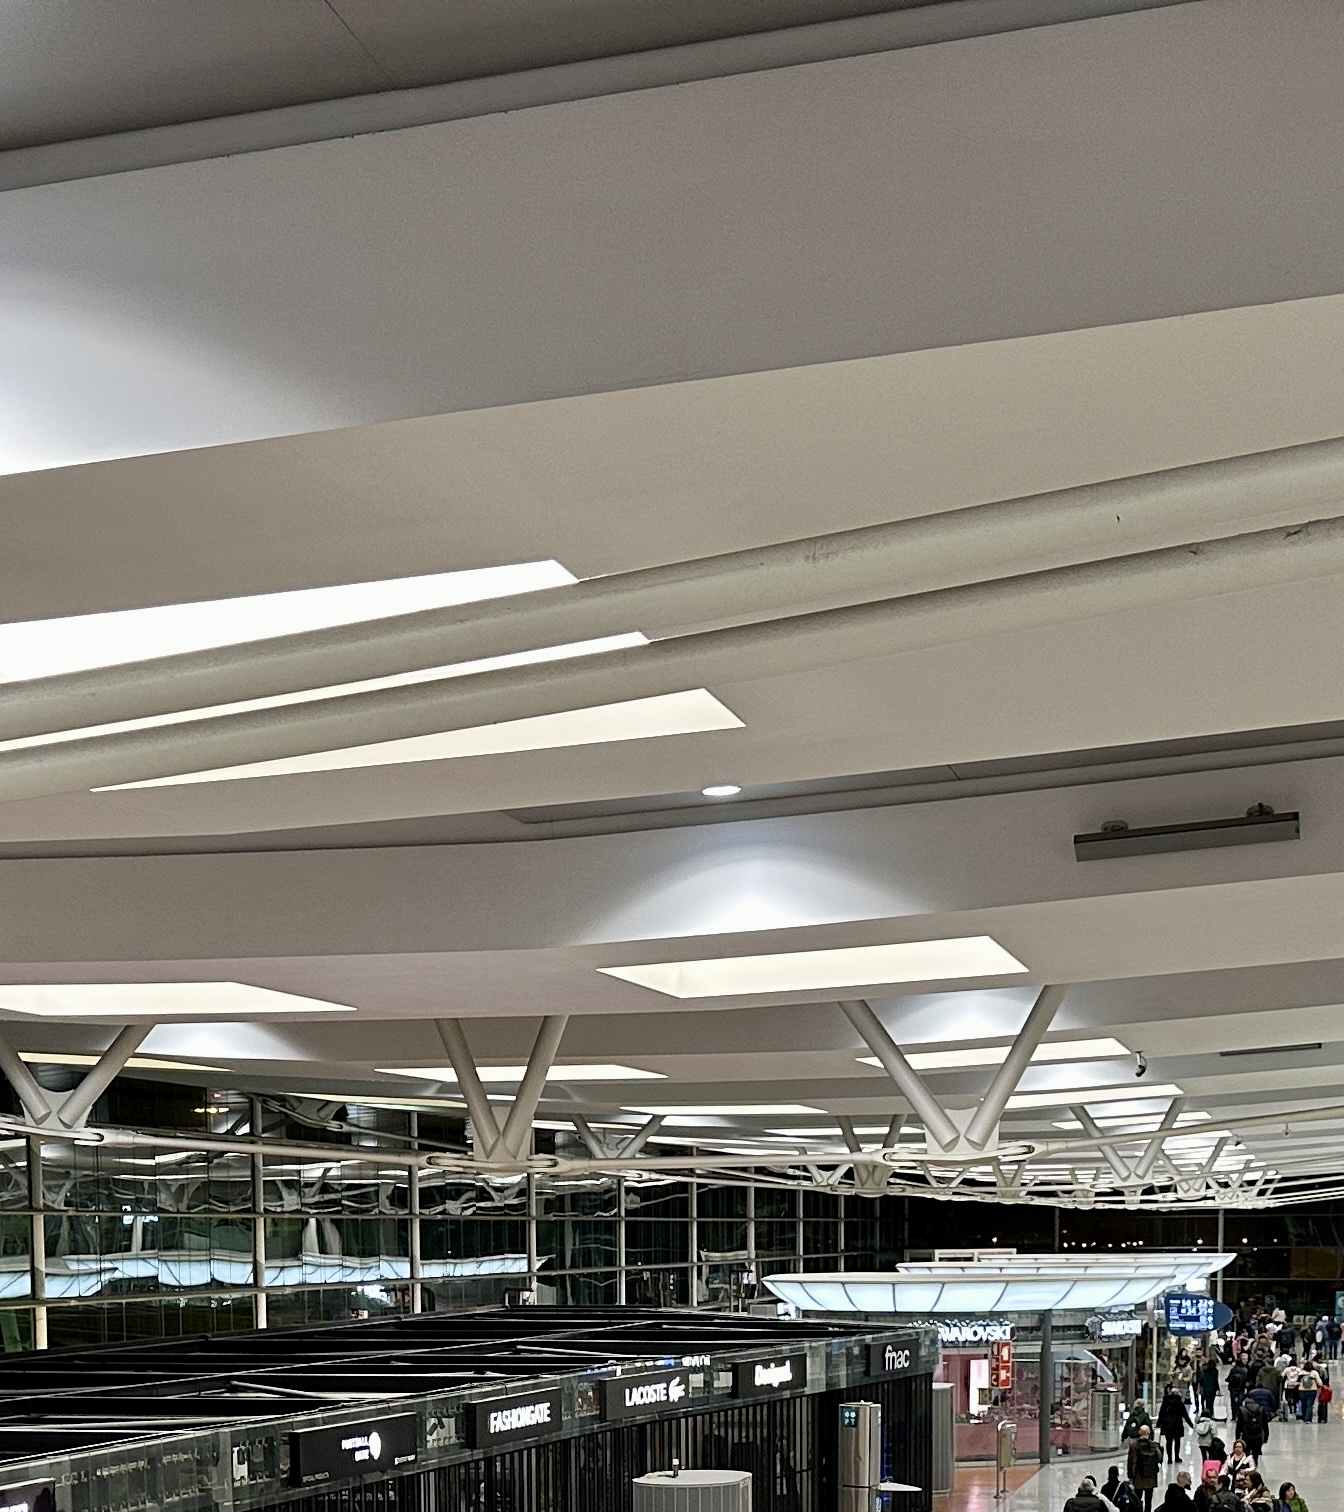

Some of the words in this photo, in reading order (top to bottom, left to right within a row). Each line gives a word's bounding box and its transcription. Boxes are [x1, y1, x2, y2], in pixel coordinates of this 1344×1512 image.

[885, 1344, 910, 1371] fnac
[625, 1383, 668, 1407] LACOSTE
[489, 1402, 551, 1433] FASHIONGATE
